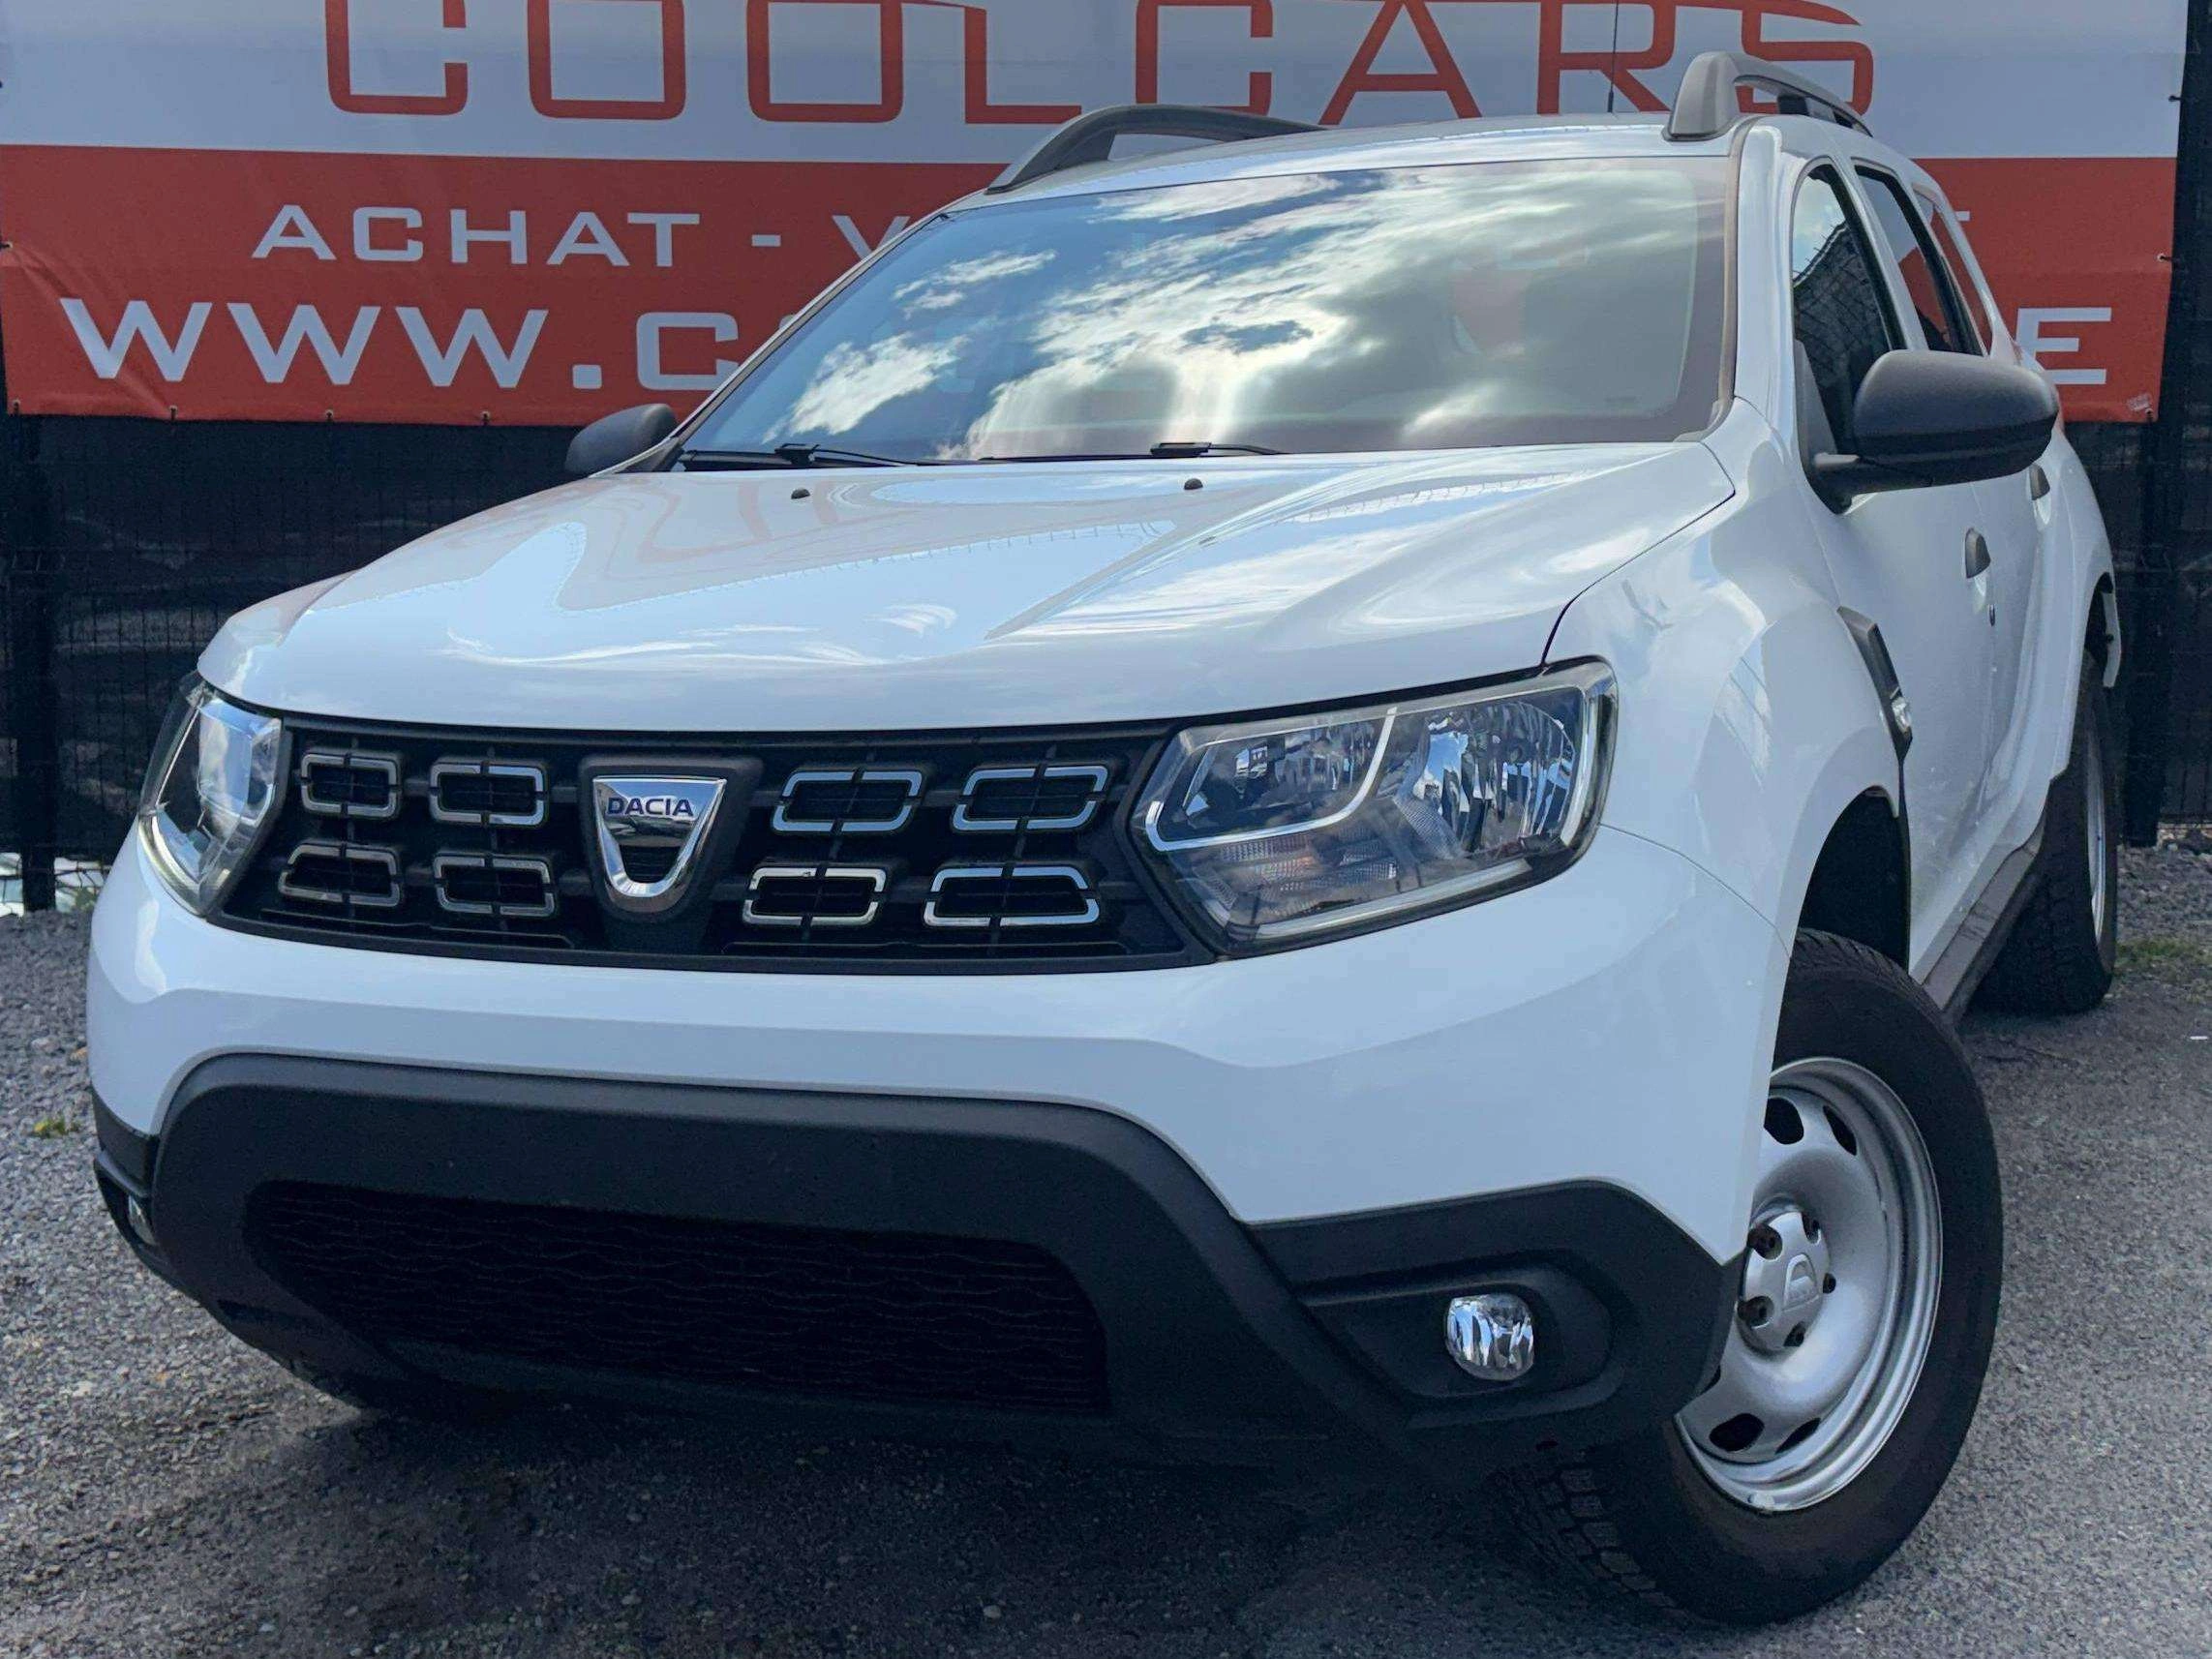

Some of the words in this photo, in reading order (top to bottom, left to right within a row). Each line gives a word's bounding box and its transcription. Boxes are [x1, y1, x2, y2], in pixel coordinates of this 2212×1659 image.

[324, 0, 1873, 125] COOLCARS
[252, 204, 700, 267] ACHAT
[60, 297, 796, 391] WWW.C
[607, 797, 694, 817] DACIA
